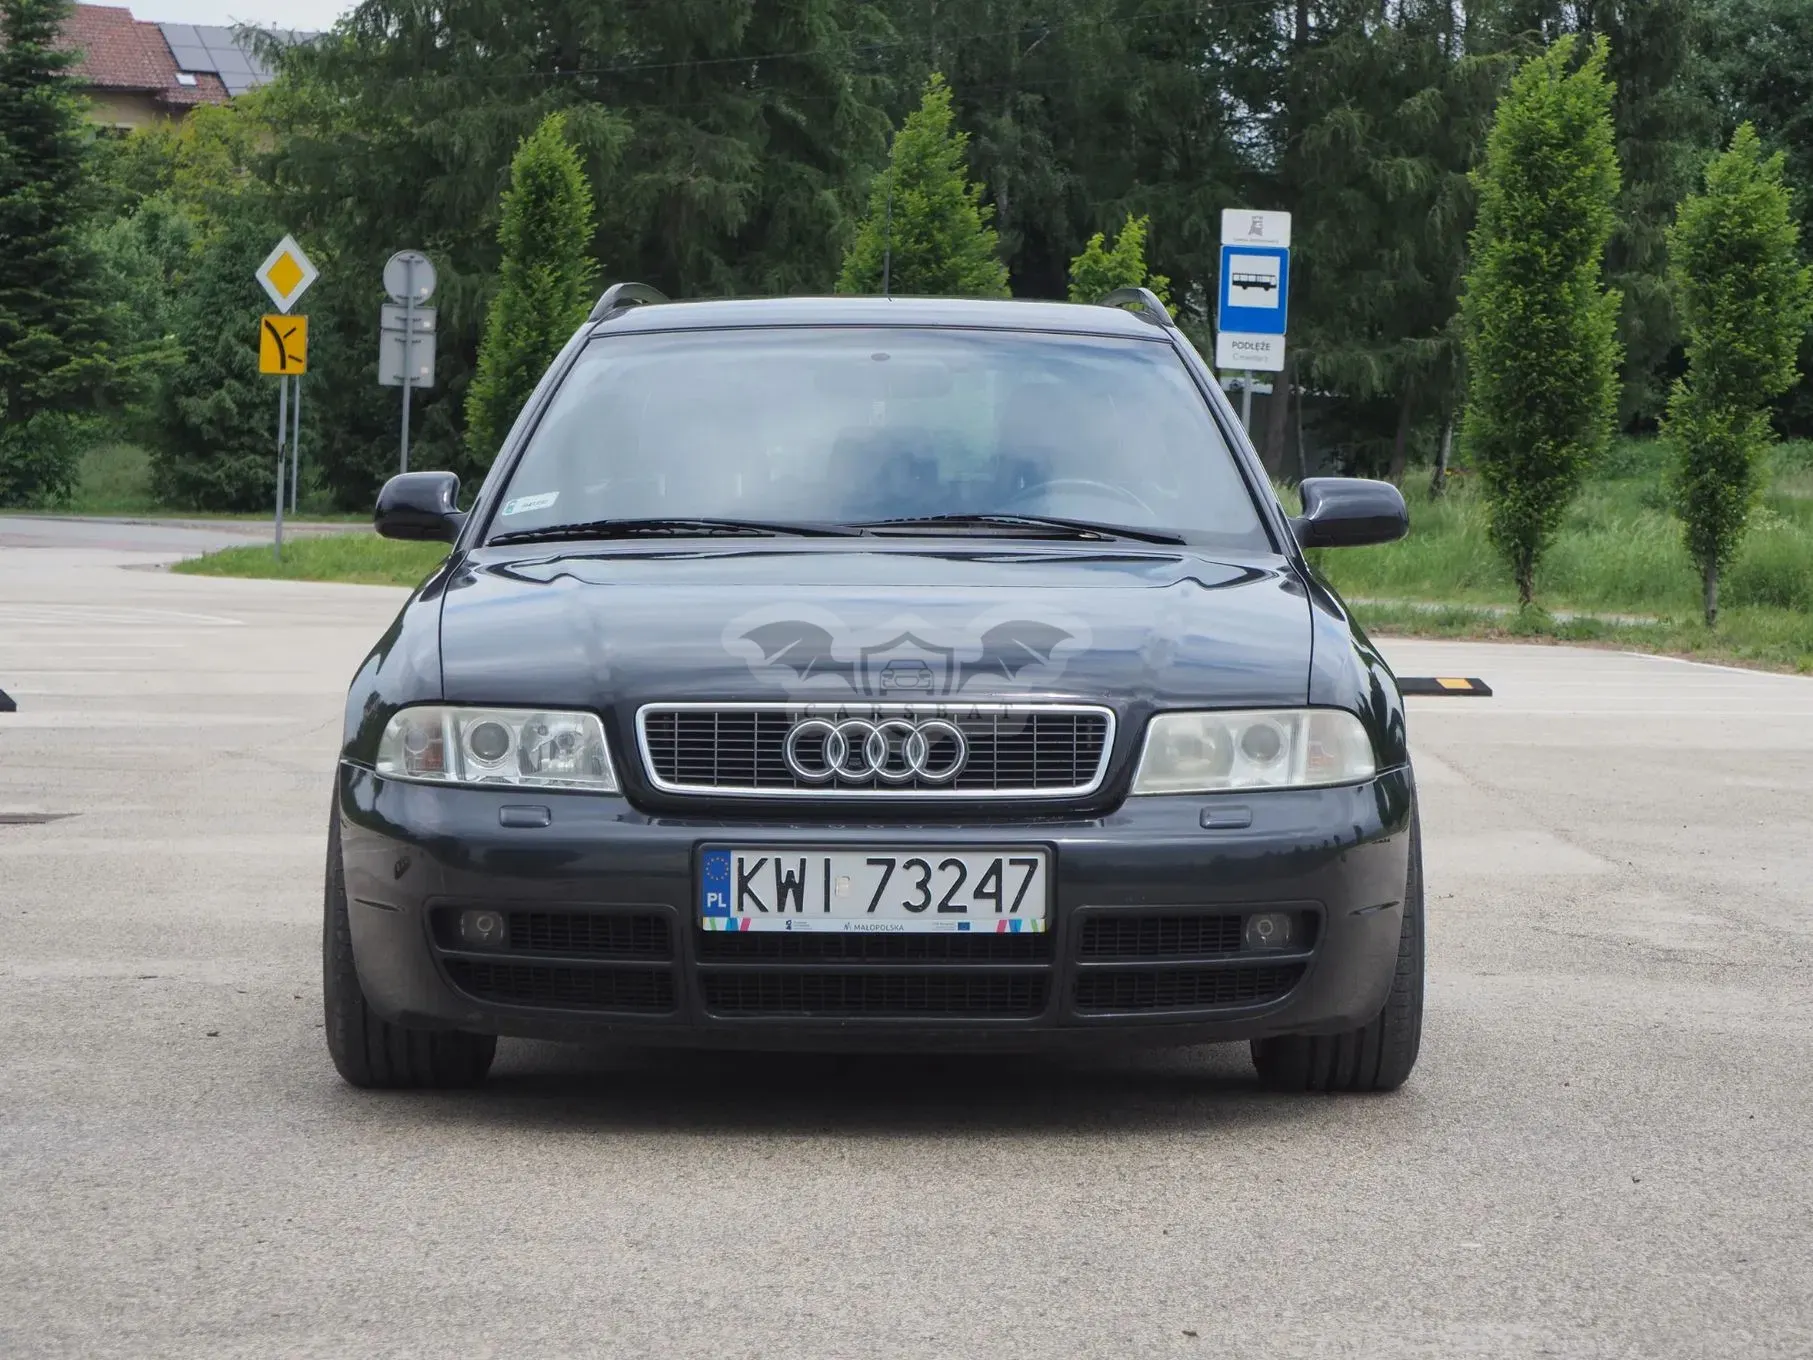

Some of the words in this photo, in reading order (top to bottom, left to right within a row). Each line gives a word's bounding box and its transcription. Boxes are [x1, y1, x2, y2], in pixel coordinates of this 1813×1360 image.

[737, 858, 831, 912] KWI
[866, 858, 1039, 913] 73247
[707, 893, 727, 908] PL
[853, 923, 905, 931] MAŁOPOLSKA
